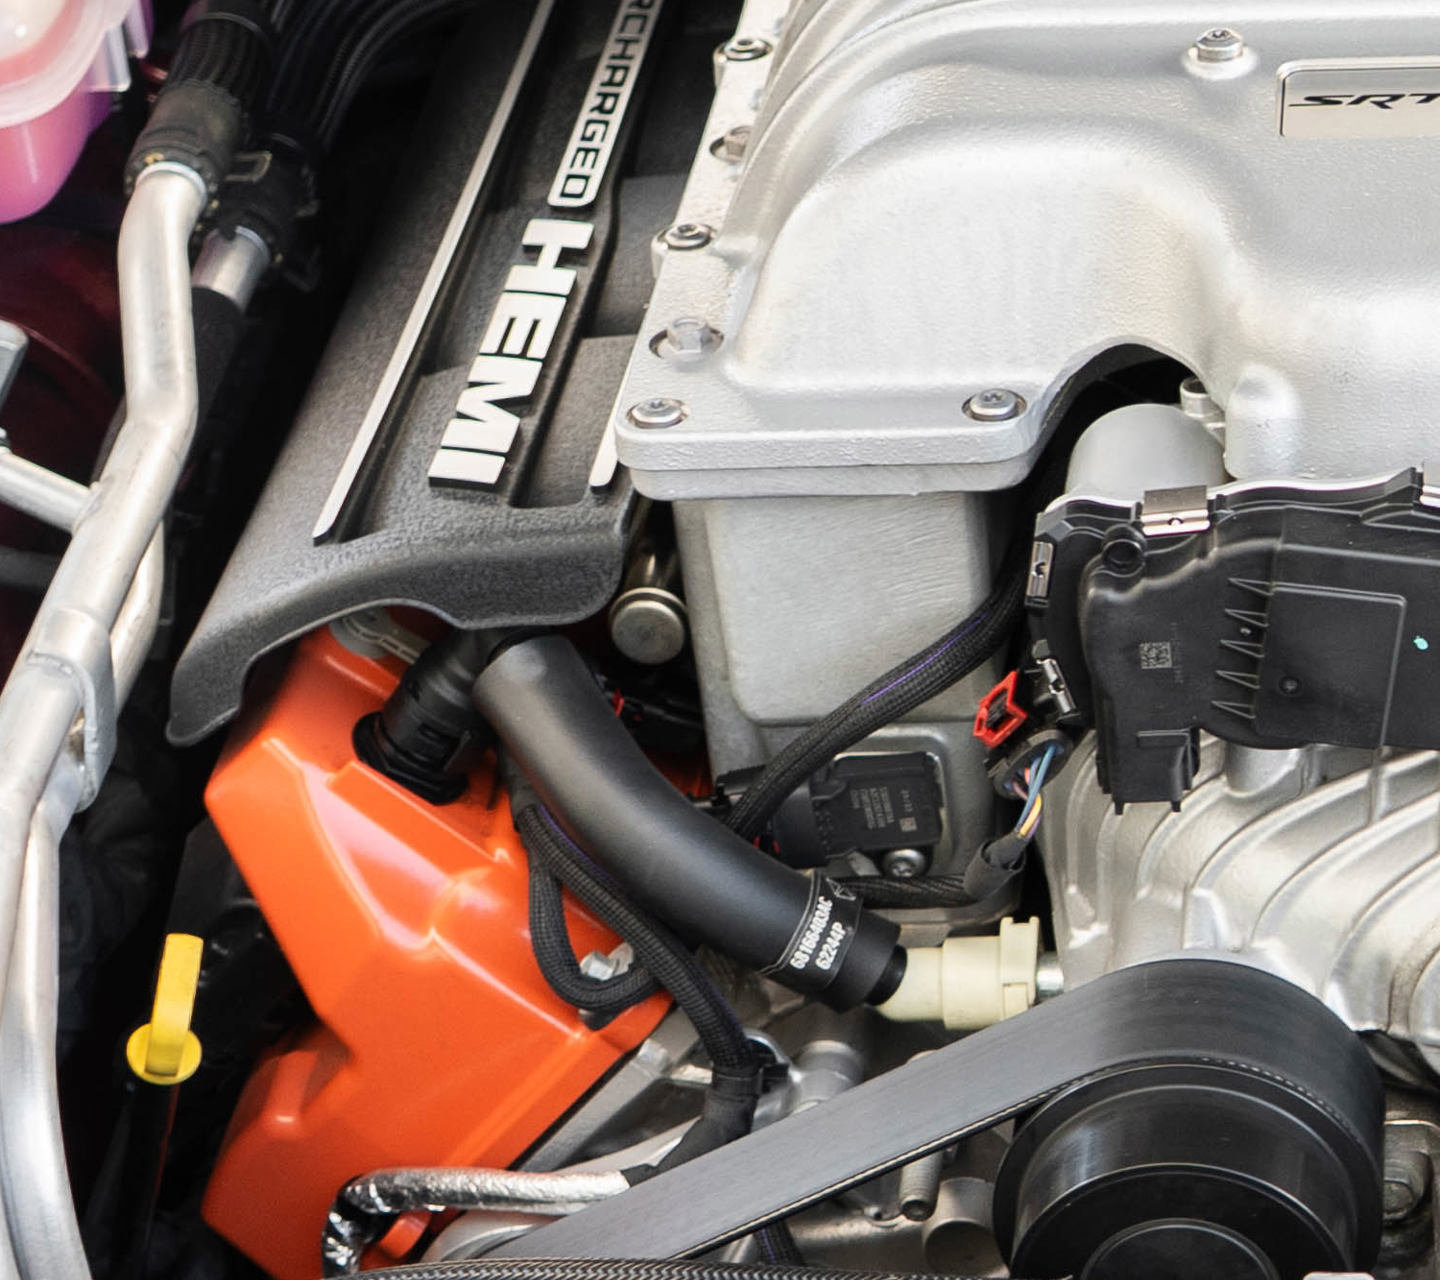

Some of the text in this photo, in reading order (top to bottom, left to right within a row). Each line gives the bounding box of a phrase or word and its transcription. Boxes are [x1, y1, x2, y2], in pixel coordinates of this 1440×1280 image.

[427, 218, 595, 486] HEMI
[789, 896, 835, 971] 68166403AC
[814, 921, 851, 971] 62244P
